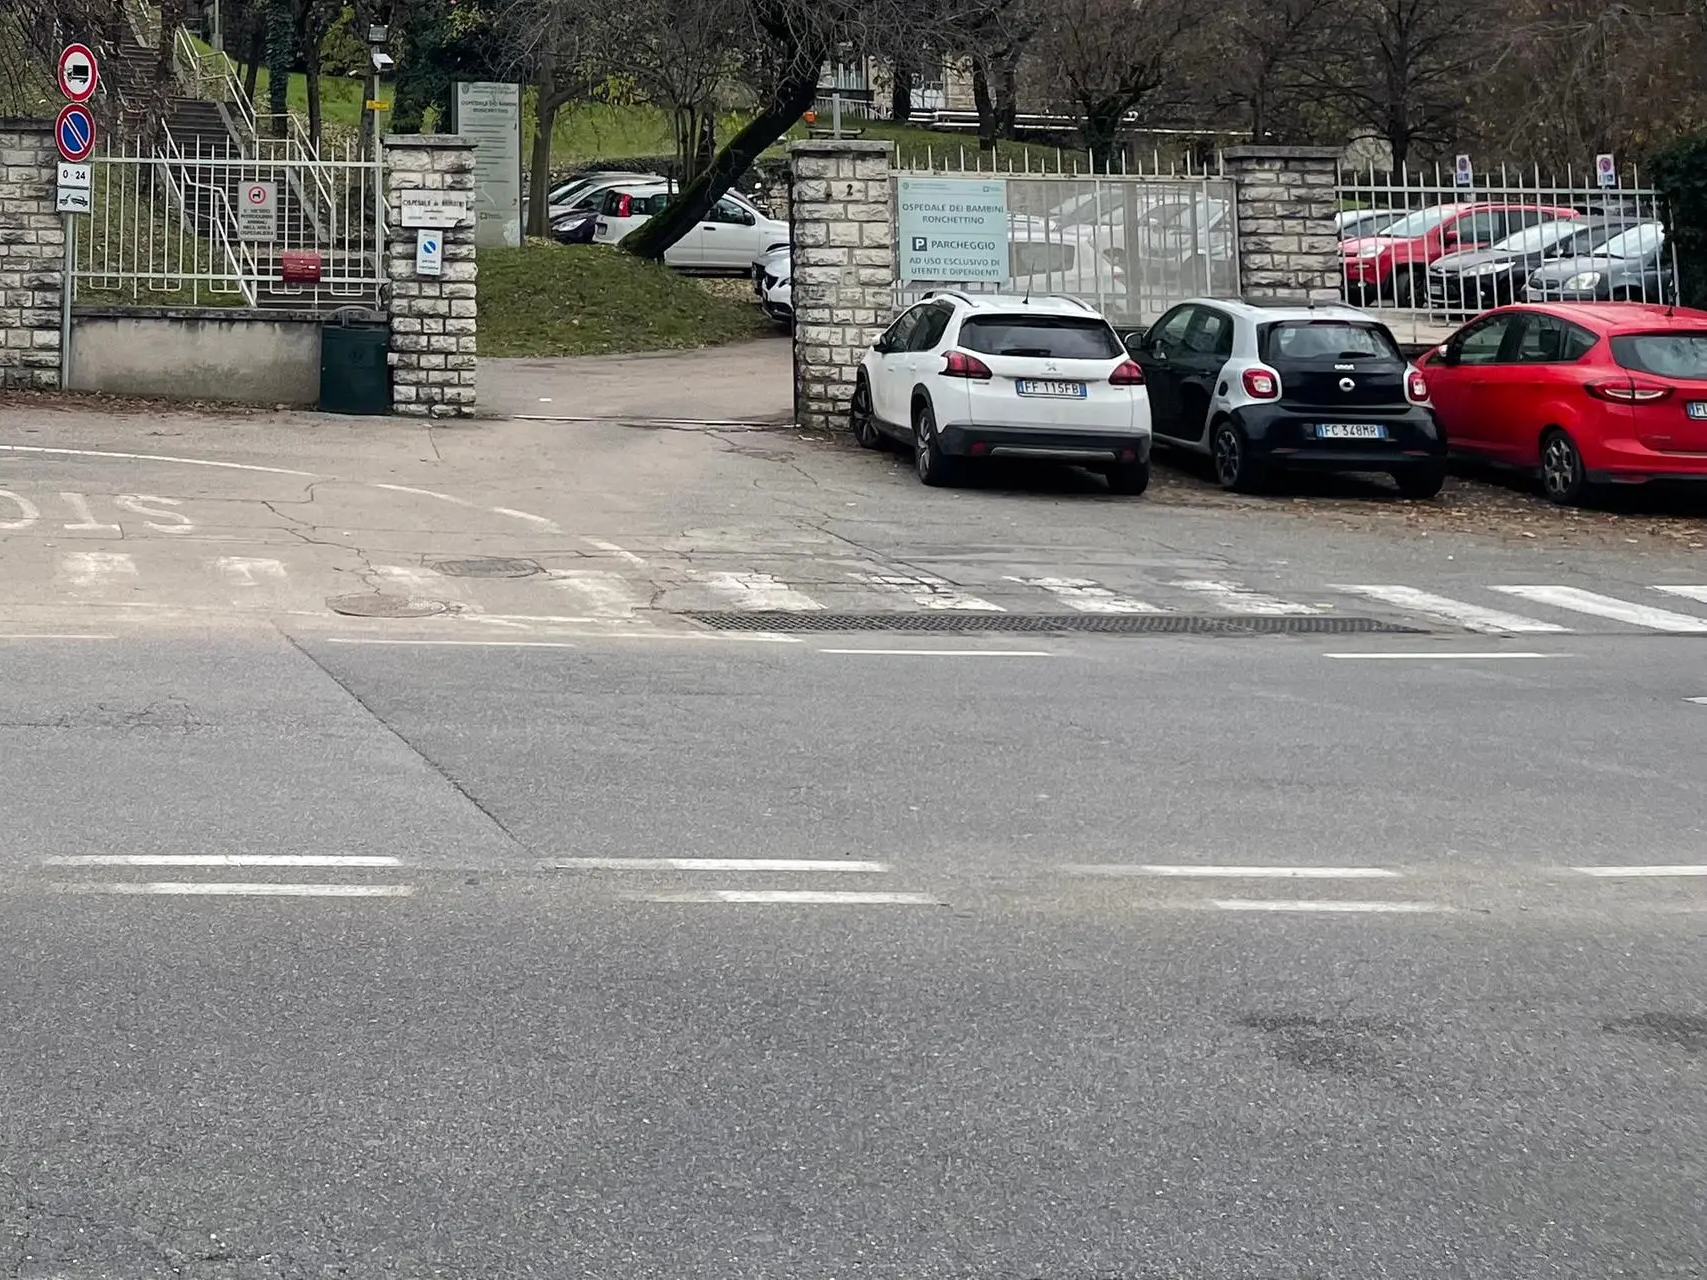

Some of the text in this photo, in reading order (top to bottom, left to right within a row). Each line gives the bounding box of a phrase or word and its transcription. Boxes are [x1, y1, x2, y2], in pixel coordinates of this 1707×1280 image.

[63, 169, 69, 179] 0
[75, 170, 86, 180] 24
[846, 183, 854, 196] 2
[902, 203, 1004, 214] OSPEDALE DEI BAMBINI
[922, 215, 985, 225] RONCHETTINO
[931, 240, 996, 250] PARCHEGGIO
[924, 257, 941, 265] USO
[943, 258, 989, 266] ESCLUSIVO
[911, 267, 940, 275] UTENTI
[949, 268, 999, 276] DIPENDENTI
[1024, 382, 1038, 393] FF
[1325, 424, 1339, 436] FC
